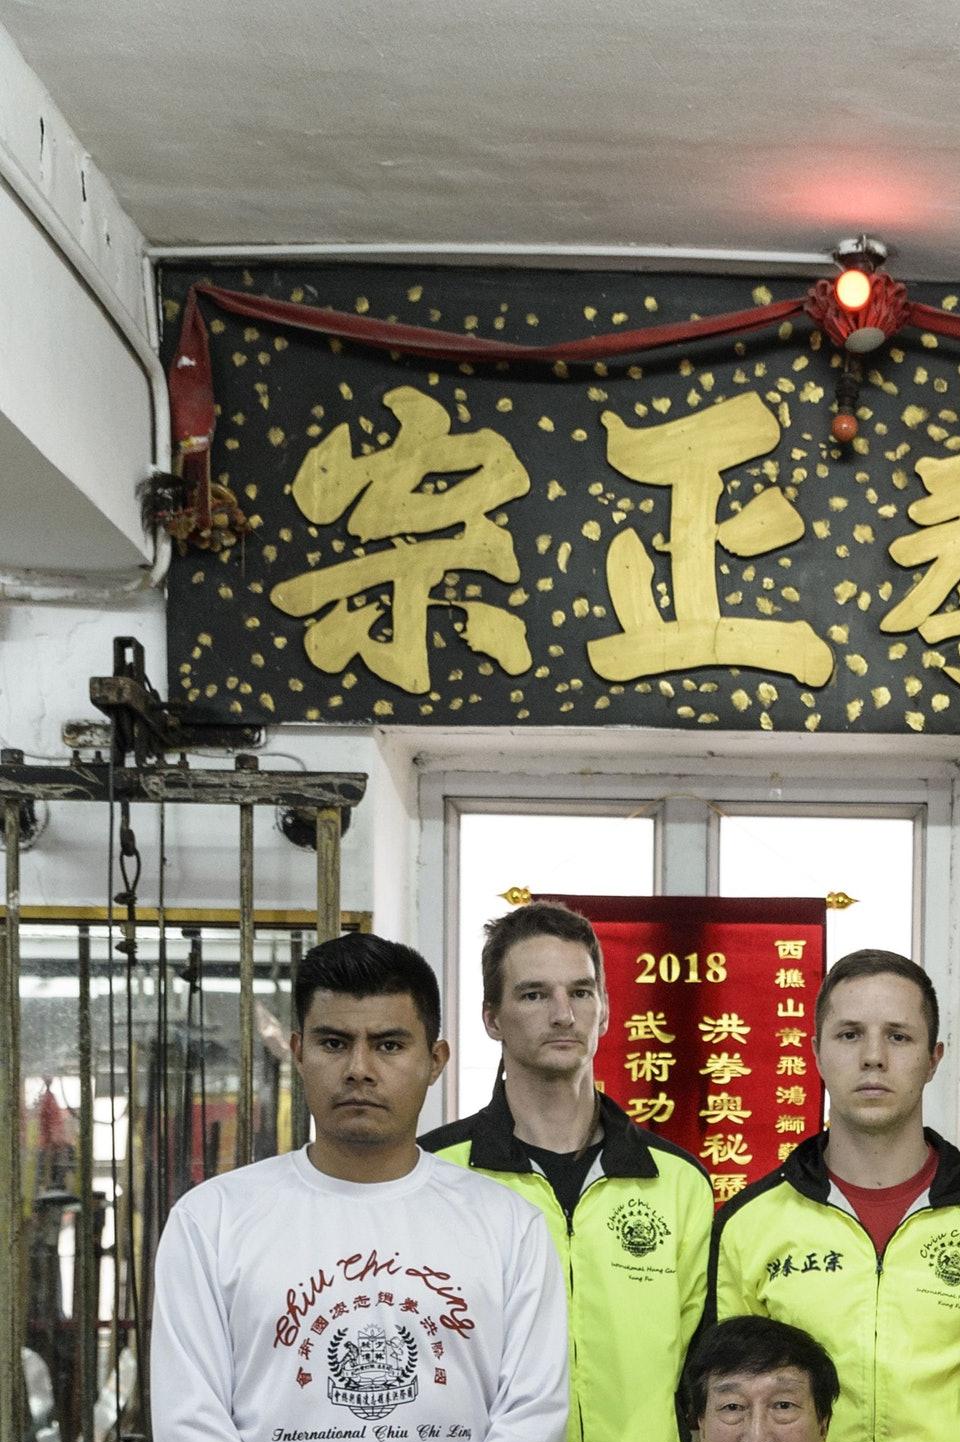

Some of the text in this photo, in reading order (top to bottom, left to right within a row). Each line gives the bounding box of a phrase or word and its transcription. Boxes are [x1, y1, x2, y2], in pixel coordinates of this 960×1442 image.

[635, 952, 728, 984] 2018
[624, 1010, 676, 1123] 武術功
[628, 1198, 650, 1210] Chi
[919, 1233, 947, 1259] Chiu
[274, 1249, 476, 1349] Chiu Chi Ling
[271, 1425, 367, 1442] International
[372, 1424, 409, 1442] Chiu
[416, 1423, 443, 1440] Chi
